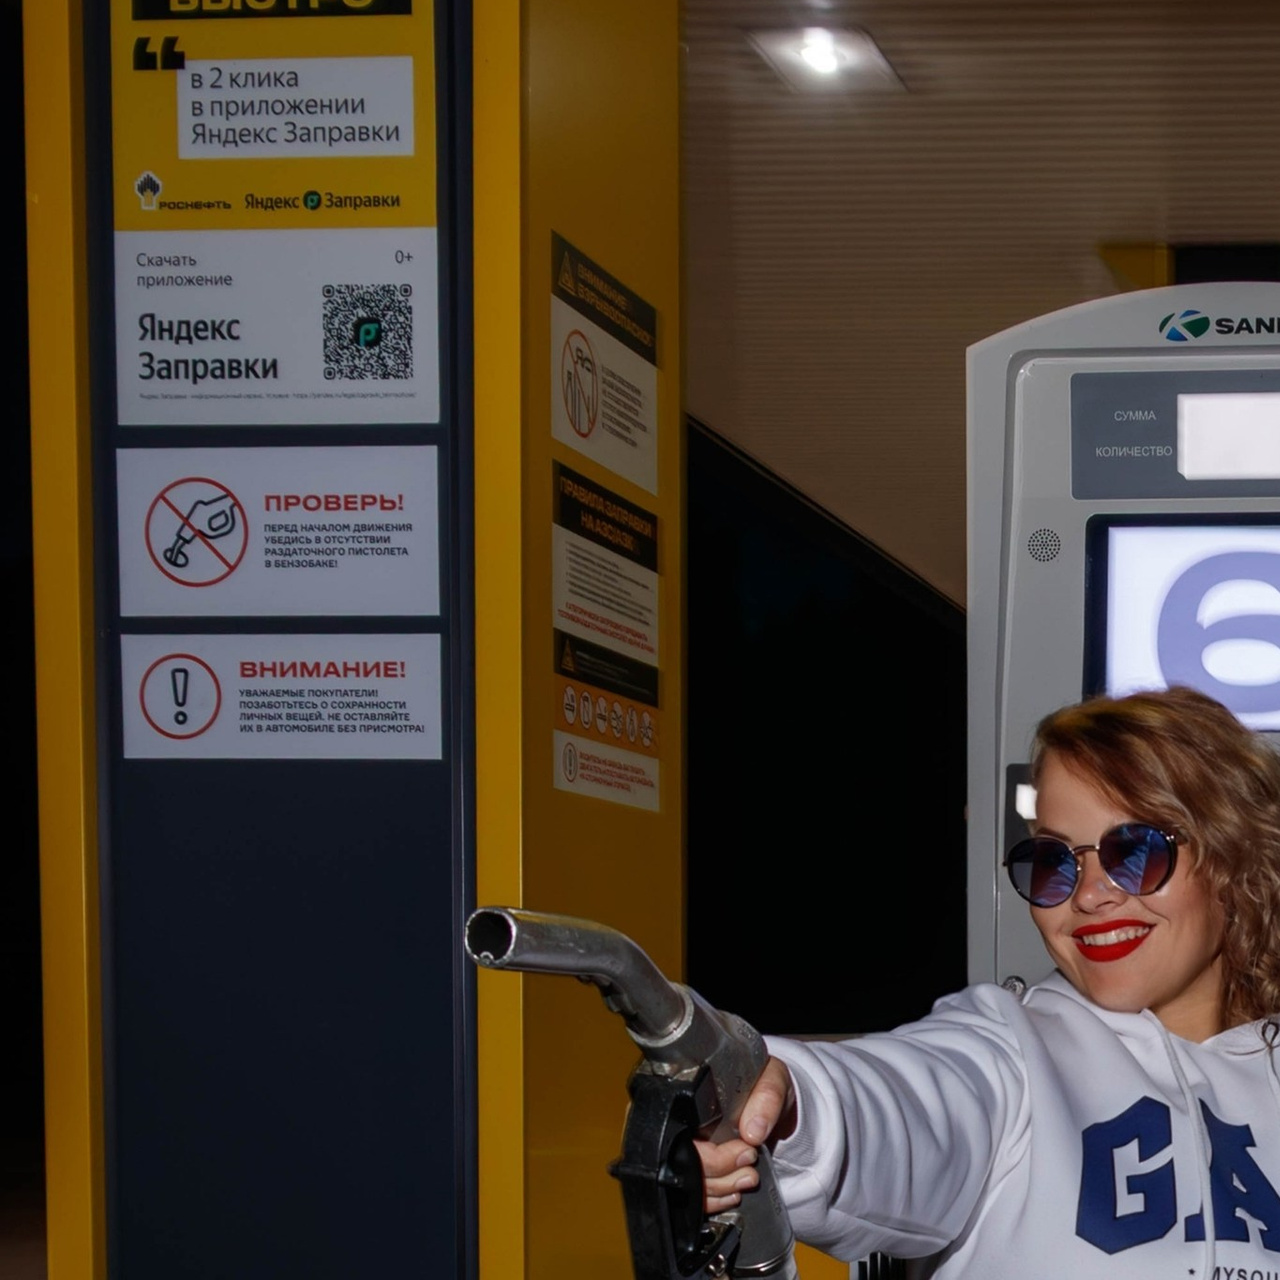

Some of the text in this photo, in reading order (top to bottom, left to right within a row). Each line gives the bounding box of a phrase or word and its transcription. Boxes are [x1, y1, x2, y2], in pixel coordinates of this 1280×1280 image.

[191, 67, 299, 88] в 2 клика
[192, 97, 365, 120] в приложении
[192, 122, 399, 147] Яндекс Заправки
[159, 200, 231, 210] РОСНЕФТЬ
[245, 192, 400, 210] Яндекс Заправки
[136, 253, 197, 267] Скачать
[395, 250, 413, 263] 0+
[137, 273, 232, 288] приложение
[139, 314, 240, 344] Яндекс
[139, 352, 278, 384] Заправки
[1114, 411, 1156, 421] СУММА
[1095, 446, 1173, 457] КОЛИЧЕСТВО
[265, 494, 403, 511] ПРОВЕРЬ!
[264, 523, 412, 533] ПЕРЕД НАЧАЛОМ ДВИЖЕНИЯ
[265, 536, 390, 545] УБЕДИСЬ В ОТСУТСТВИИ
[265, 547, 408, 557] РАЗДАТОЧНОГО ПИСТОЛЕТА
[265, 560, 338, 568] В БЕНЗОБАКЕ!
[240, 661, 405, 678] ВНИМАНИЕ!
[239, 689, 378, 697] УВАЖАЕМЫЕ ПОКУПАТЕЛИ!
[239, 701, 406, 709] ПОЗАБОТЬТЕСЬ О СОХРАННОСТИ
[239, 711, 410, 722] ЛИЧНЫХ ВЕЩЕЙ. НЕ ОСТАВЛЯЙТЕ
[240, 725, 425, 733] ИХ В АВТОМОБИЛЕ БЕЗ ПРИСМОТРА!
